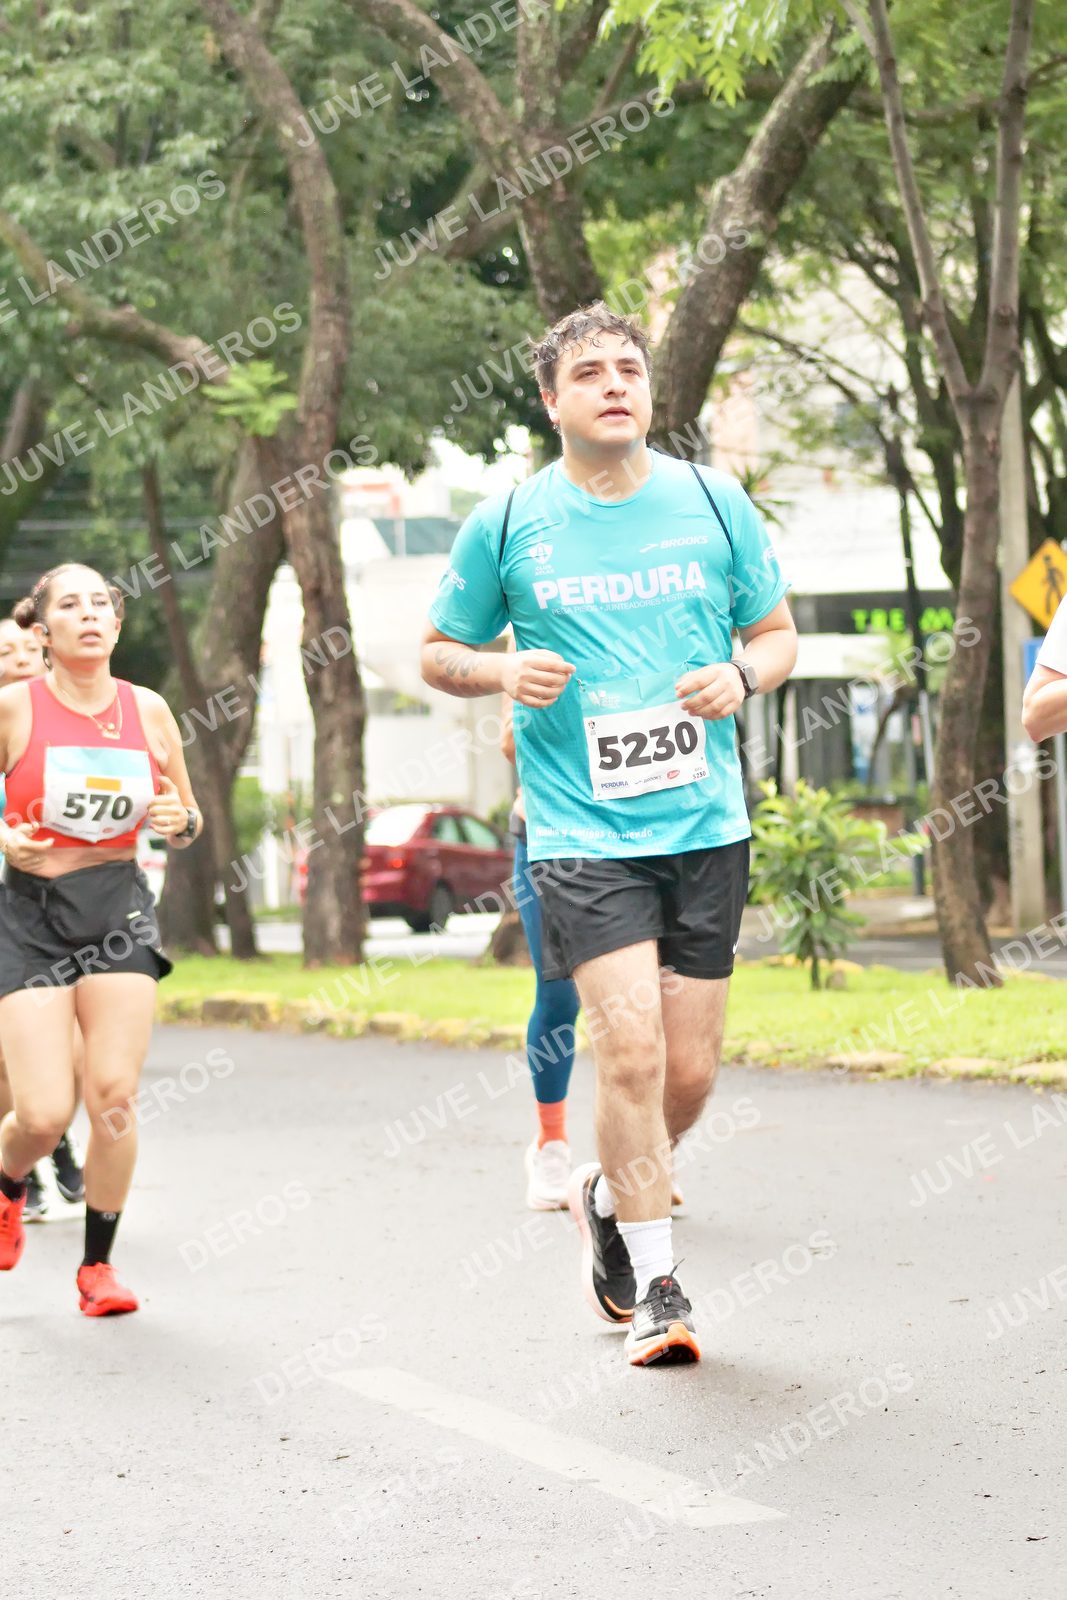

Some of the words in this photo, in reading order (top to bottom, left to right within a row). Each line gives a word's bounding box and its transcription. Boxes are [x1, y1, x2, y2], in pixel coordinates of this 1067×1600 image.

[660, 535, 709, 549] BROOKS
[532, 561, 707, 610] PERDURA
[604, 598, 661, 612] JUNTEADORES
[597, 721, 698, 770] 5230
[62, 792, 133, 821] 570
